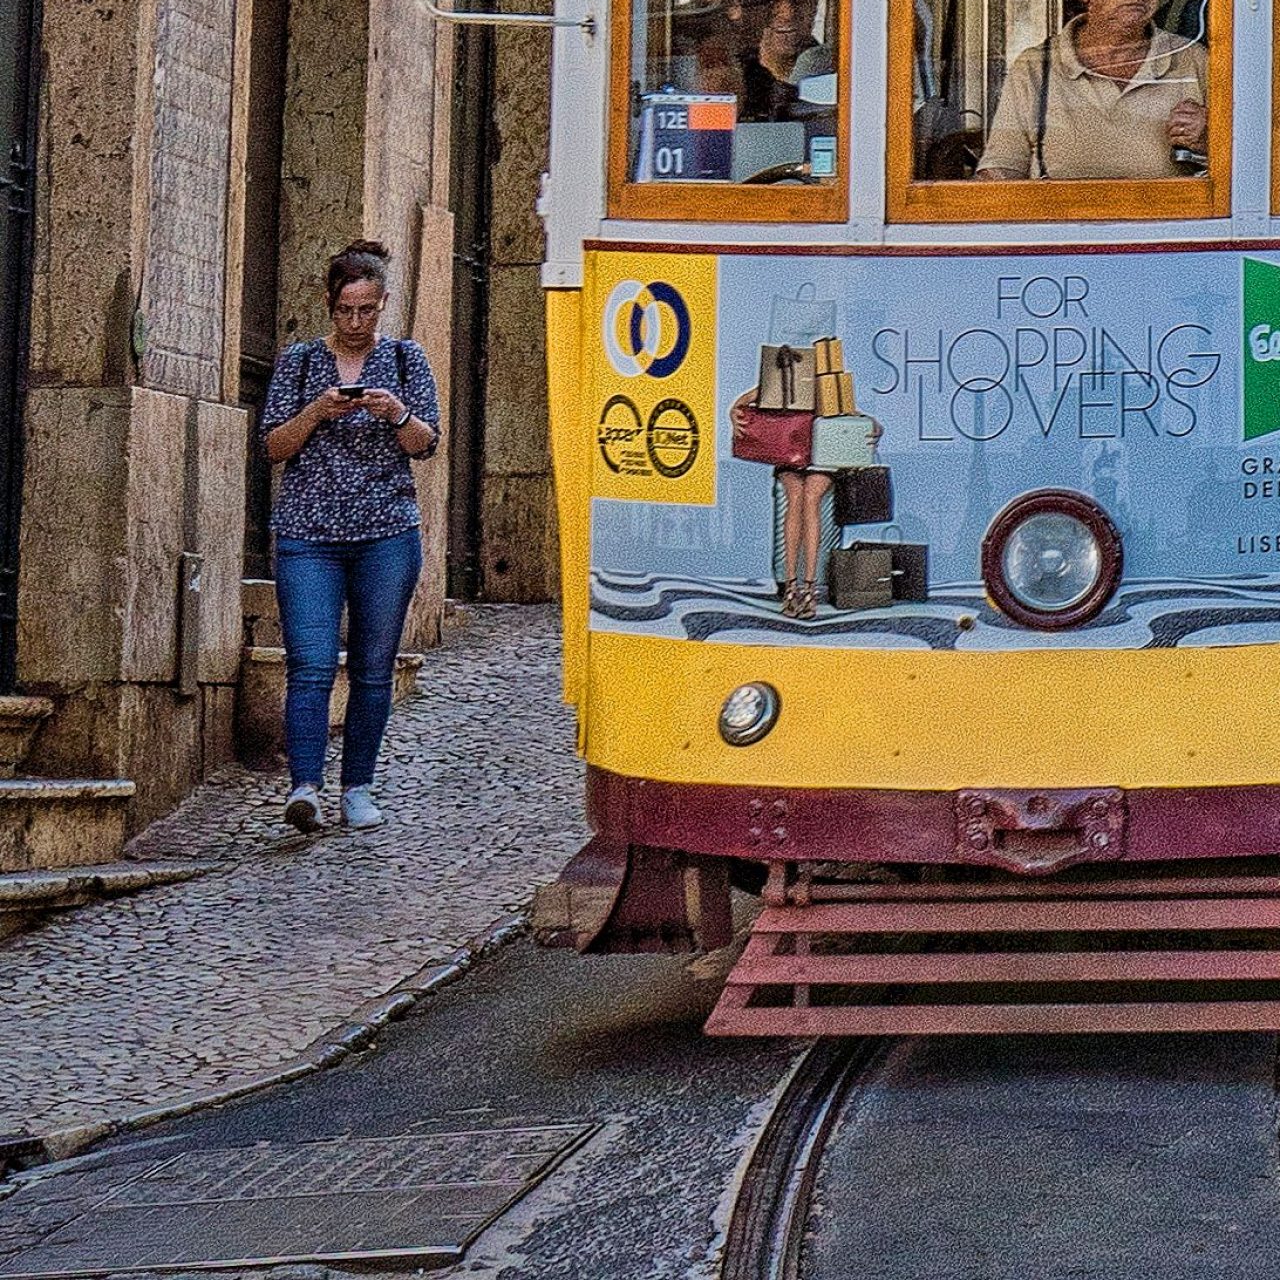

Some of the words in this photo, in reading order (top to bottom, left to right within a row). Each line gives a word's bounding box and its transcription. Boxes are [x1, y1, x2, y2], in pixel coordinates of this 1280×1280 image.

[657, 111, 688, 129] 12E
[655, 147, 684, 174] 01
[997, 276, 1090, 319] FOR
[872, 324, 1221, 396] SHOPPING
[918, 368, 1198, 441] LOVERS
